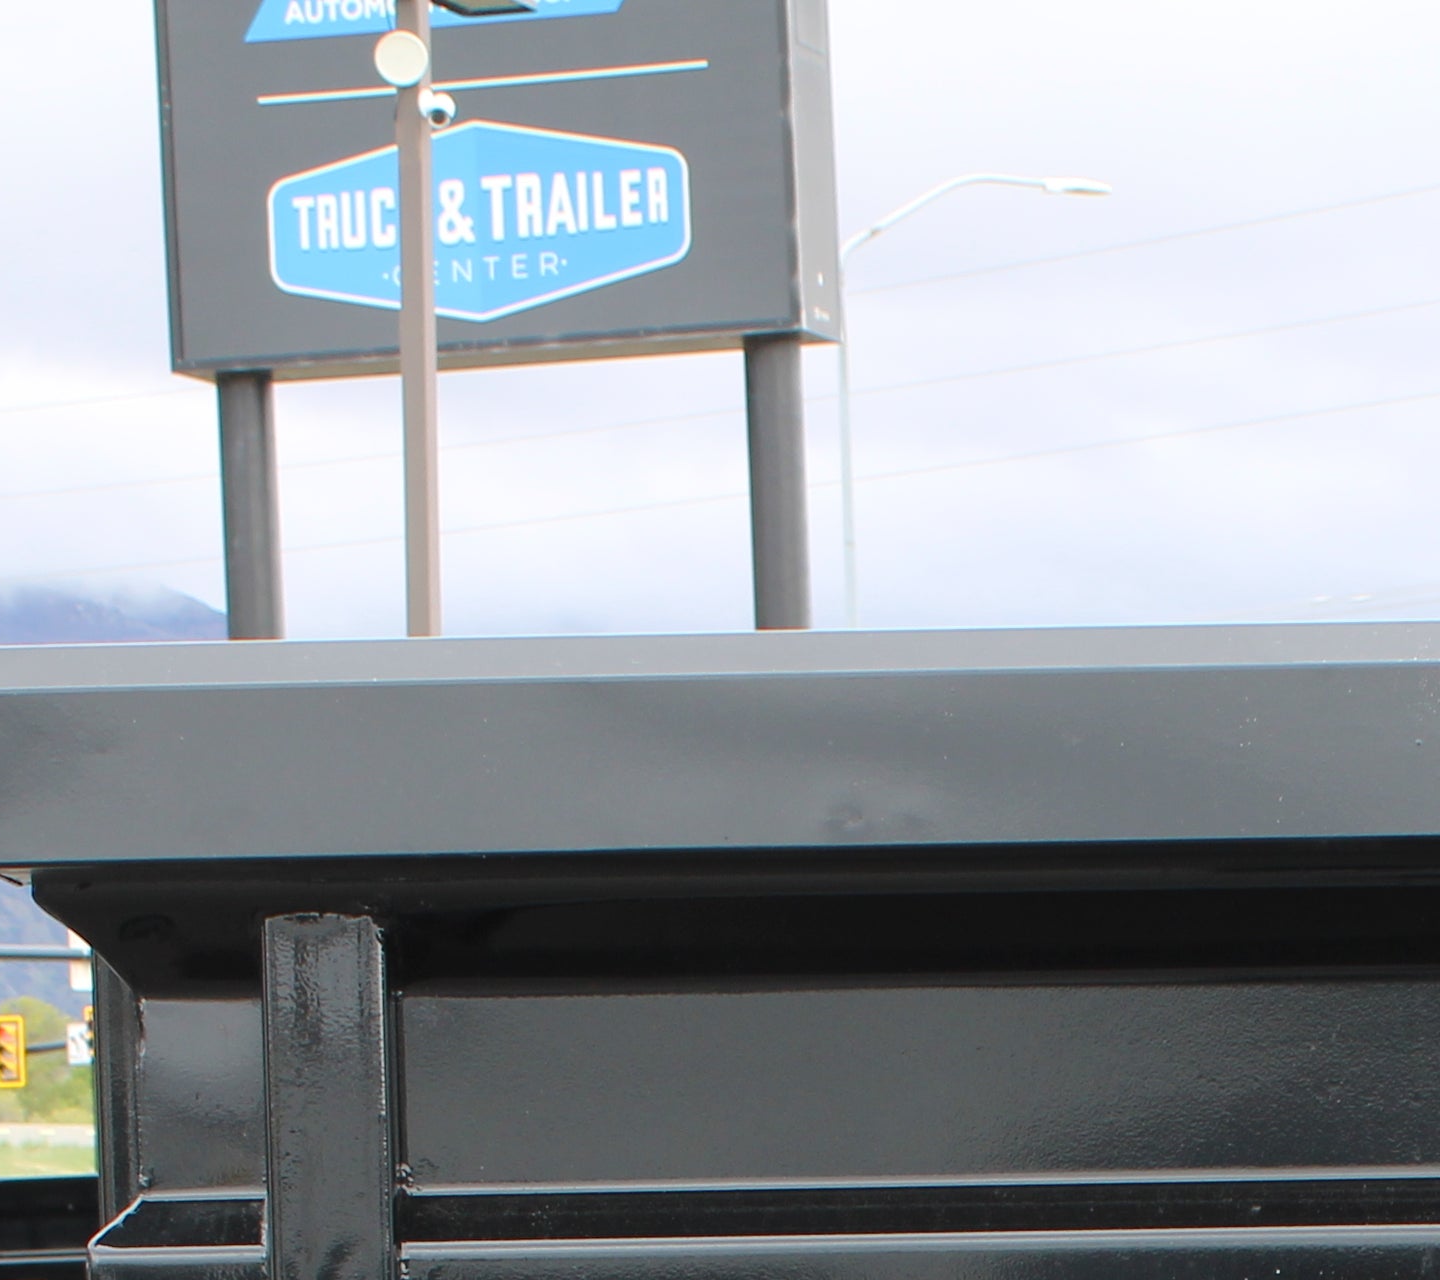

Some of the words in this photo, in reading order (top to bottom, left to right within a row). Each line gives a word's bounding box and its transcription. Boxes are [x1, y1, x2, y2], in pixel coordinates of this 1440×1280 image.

[292, 186, 397, 251] TRUC
[438, 178, 476, 246] &
[480, 166, 669, 242] TRAILER
[392, 250, 560, 286] NTER
